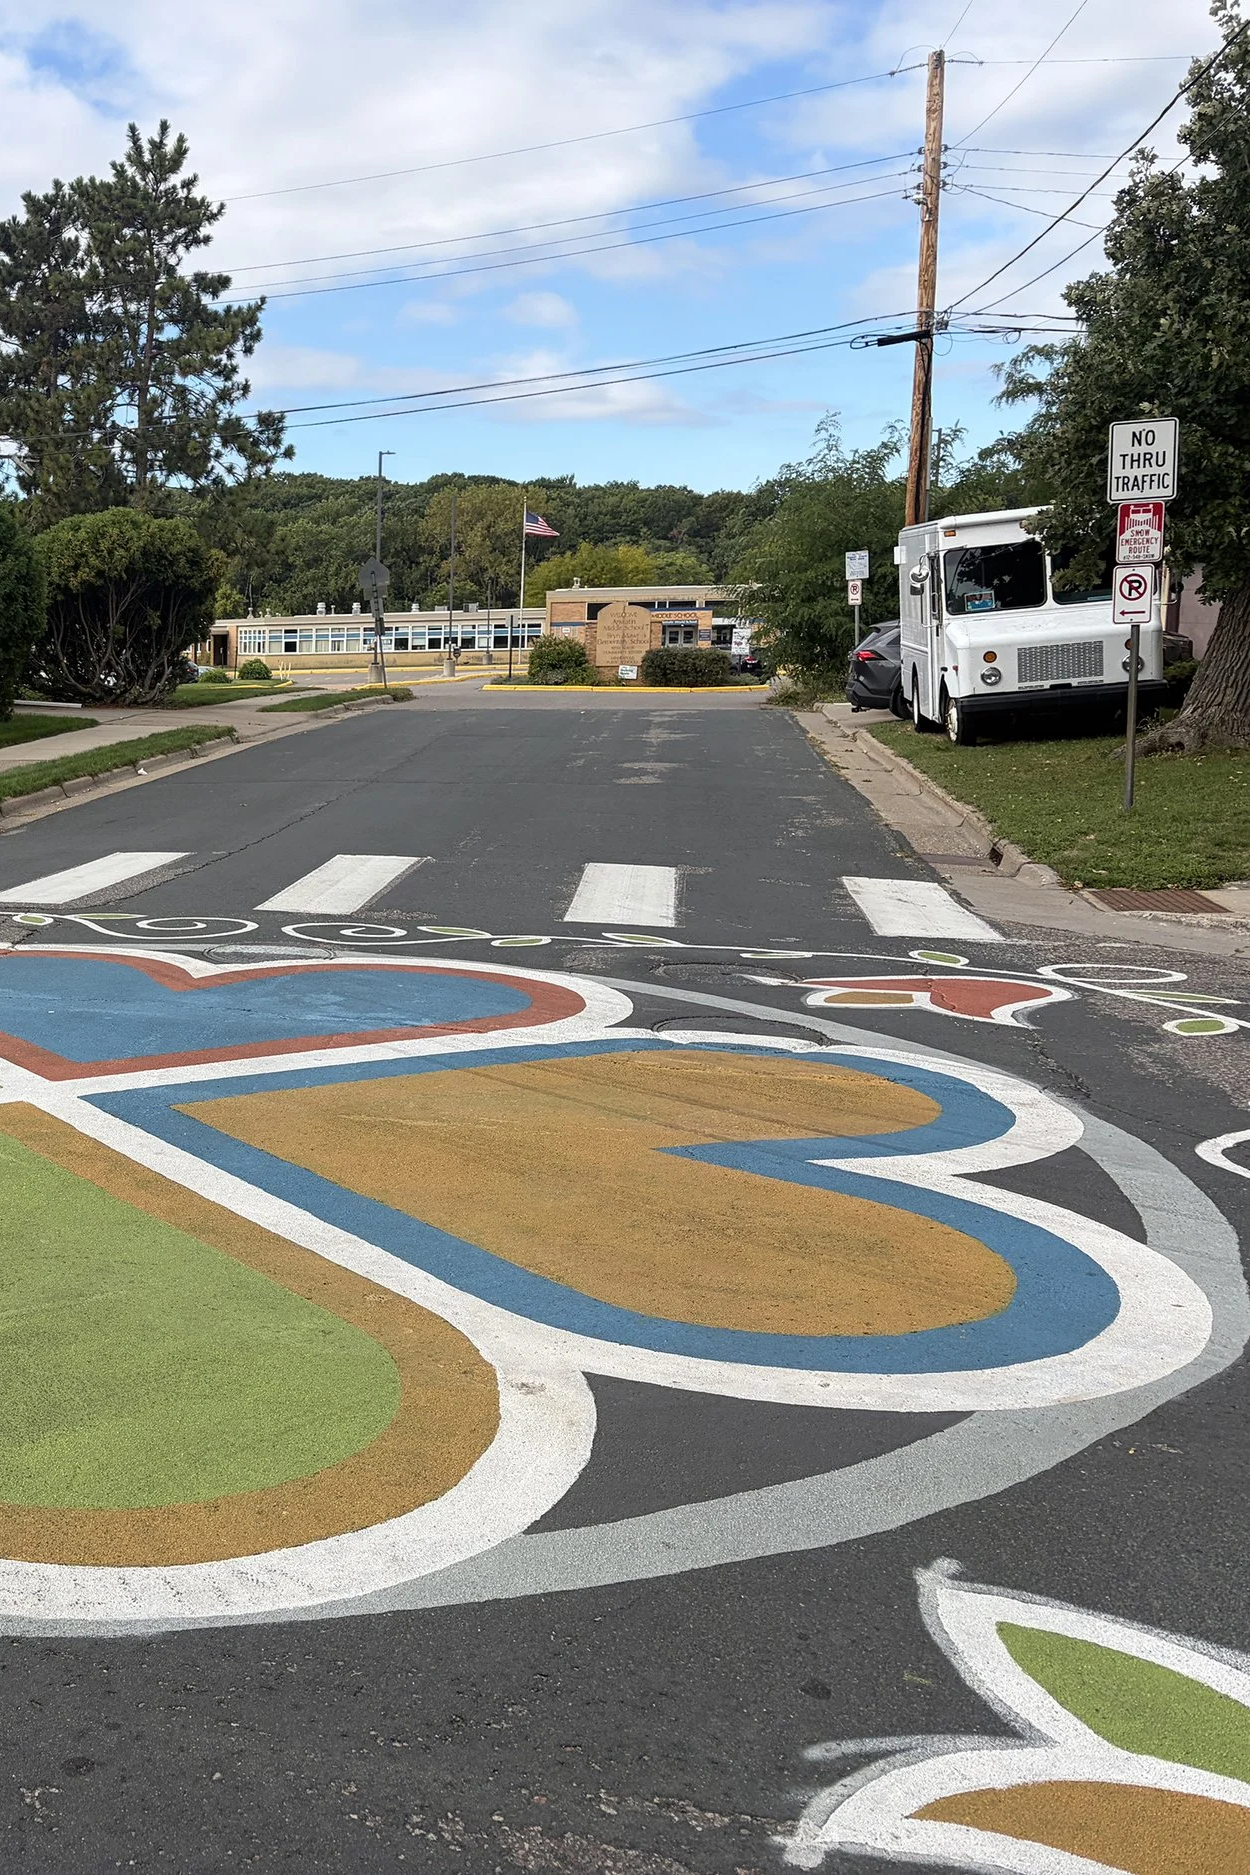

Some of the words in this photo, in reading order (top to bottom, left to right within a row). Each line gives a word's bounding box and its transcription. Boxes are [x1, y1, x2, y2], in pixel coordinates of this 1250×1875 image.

[1131, 429, 1156, 447] NO
[1119, 451, 1166, 470] THRU
[1114, 472, 1170, 493] TRAFFIC
[1130, 529, 1151, 537] SNOW
[1121, 537, 1159, 546] EMERGENCY
[1128, 545, 1150, 554] ROUTE
